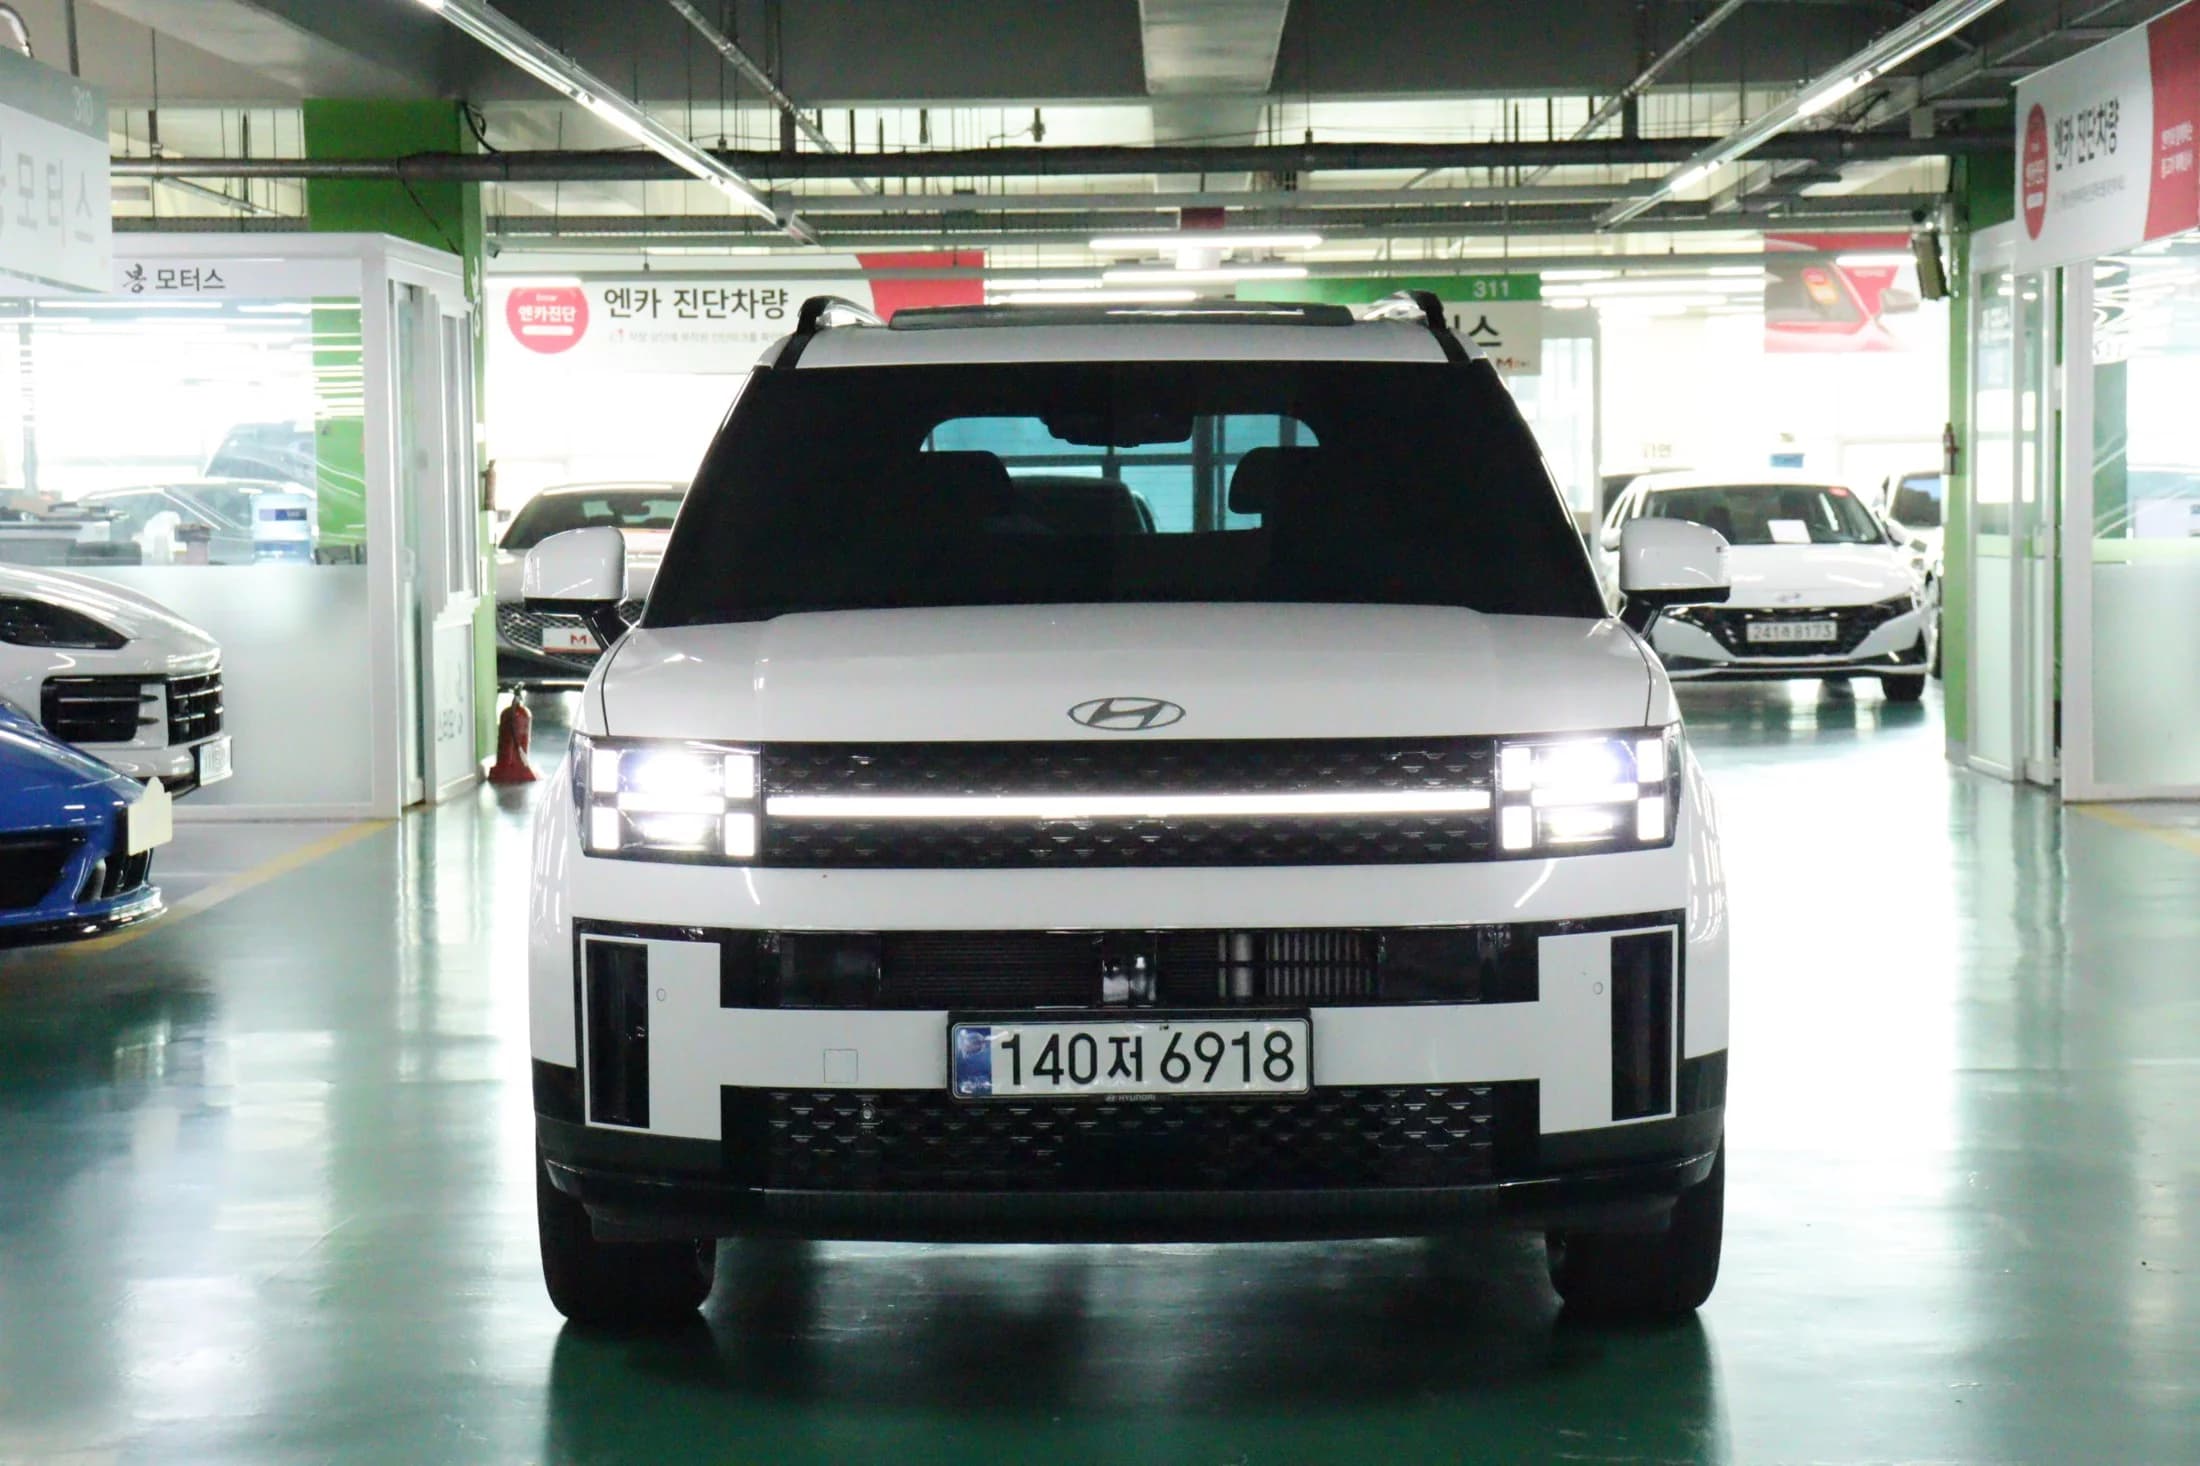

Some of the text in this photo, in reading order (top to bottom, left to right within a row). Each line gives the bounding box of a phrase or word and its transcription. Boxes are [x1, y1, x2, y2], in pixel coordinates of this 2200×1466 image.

[2077, 97, 2120, 165] 진단차량
[16, 152, 95, 249] 모터스
[155, 267, 226, 292] 모터스
[1473, 280, 1509, 298] 311
[518, 304, 577, 323] 엔카진단
[603, 287, 790, 320] 엔카 진단차량
